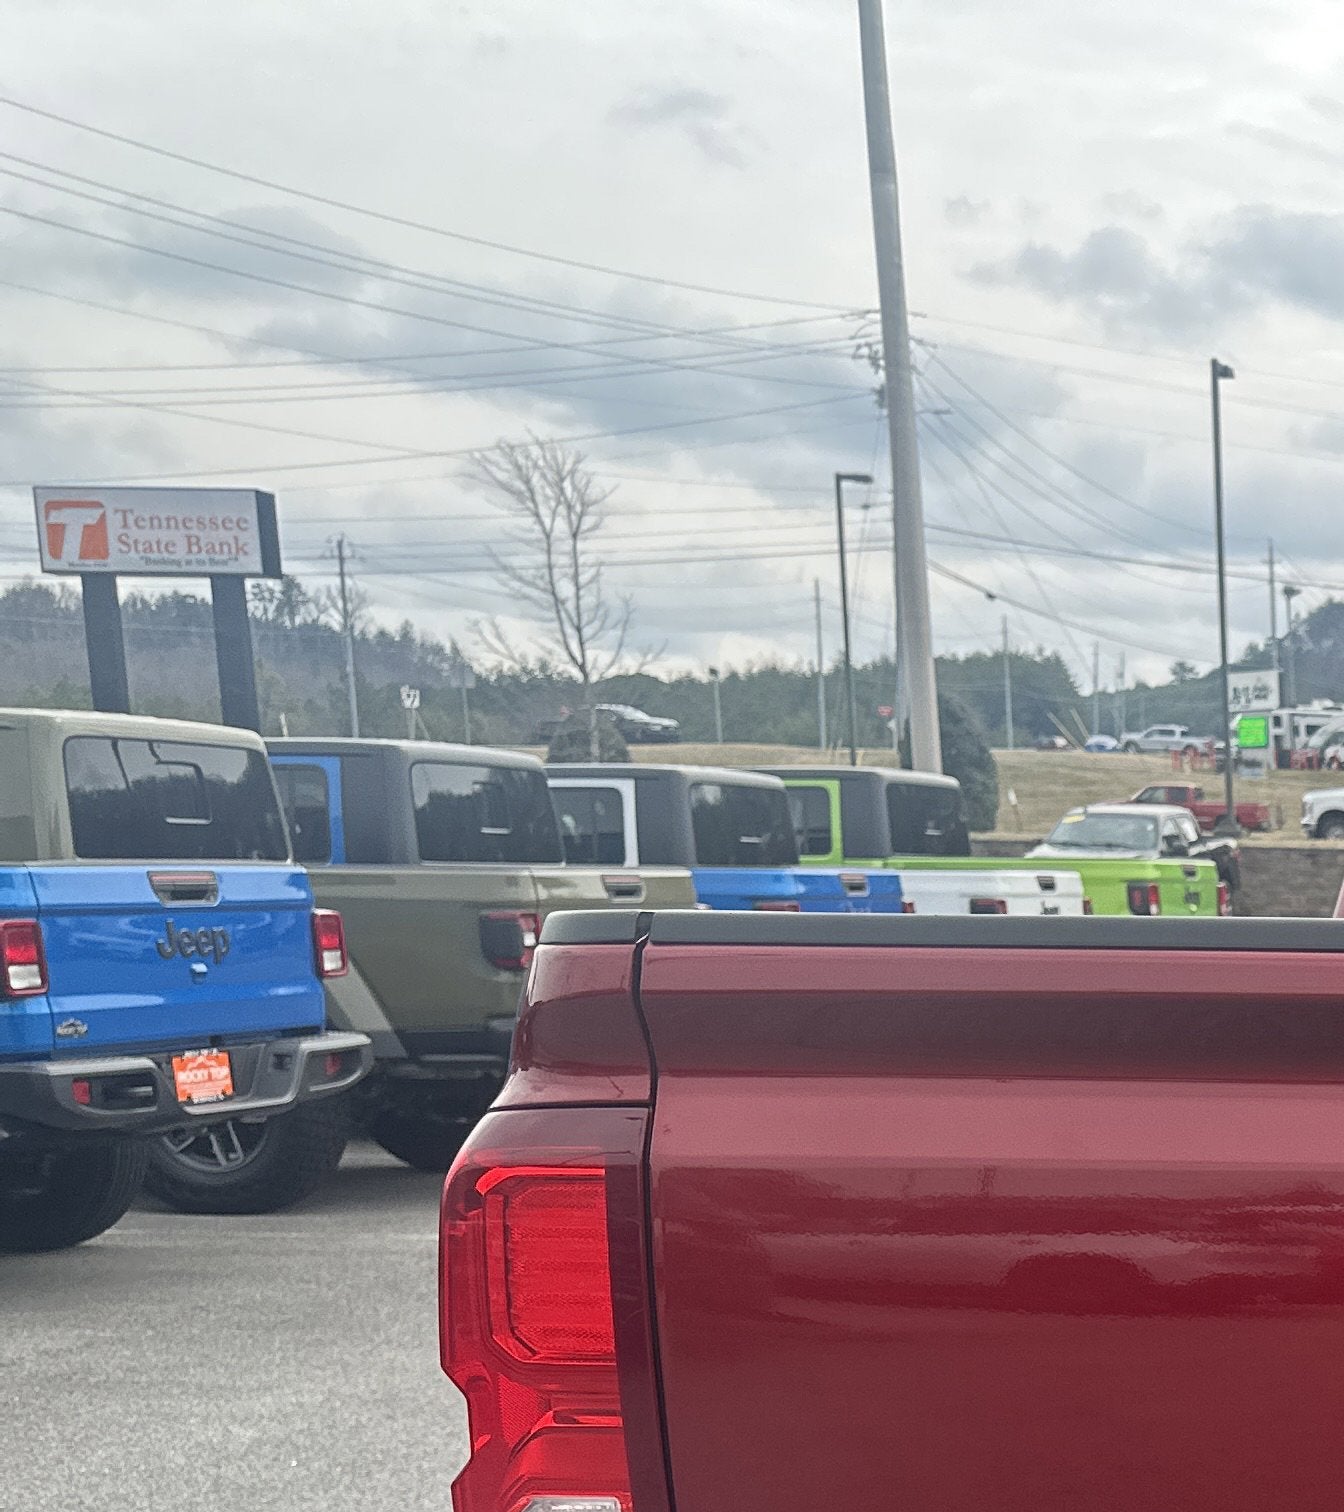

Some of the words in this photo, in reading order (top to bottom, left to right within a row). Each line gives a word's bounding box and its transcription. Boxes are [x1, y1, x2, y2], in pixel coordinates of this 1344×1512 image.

[113, 508, 249, 532] Tennessee
[117, 533, 176, 555] State
[185, 534, 249, 556] Bank
[156, 918, 230, 964] Jeep
